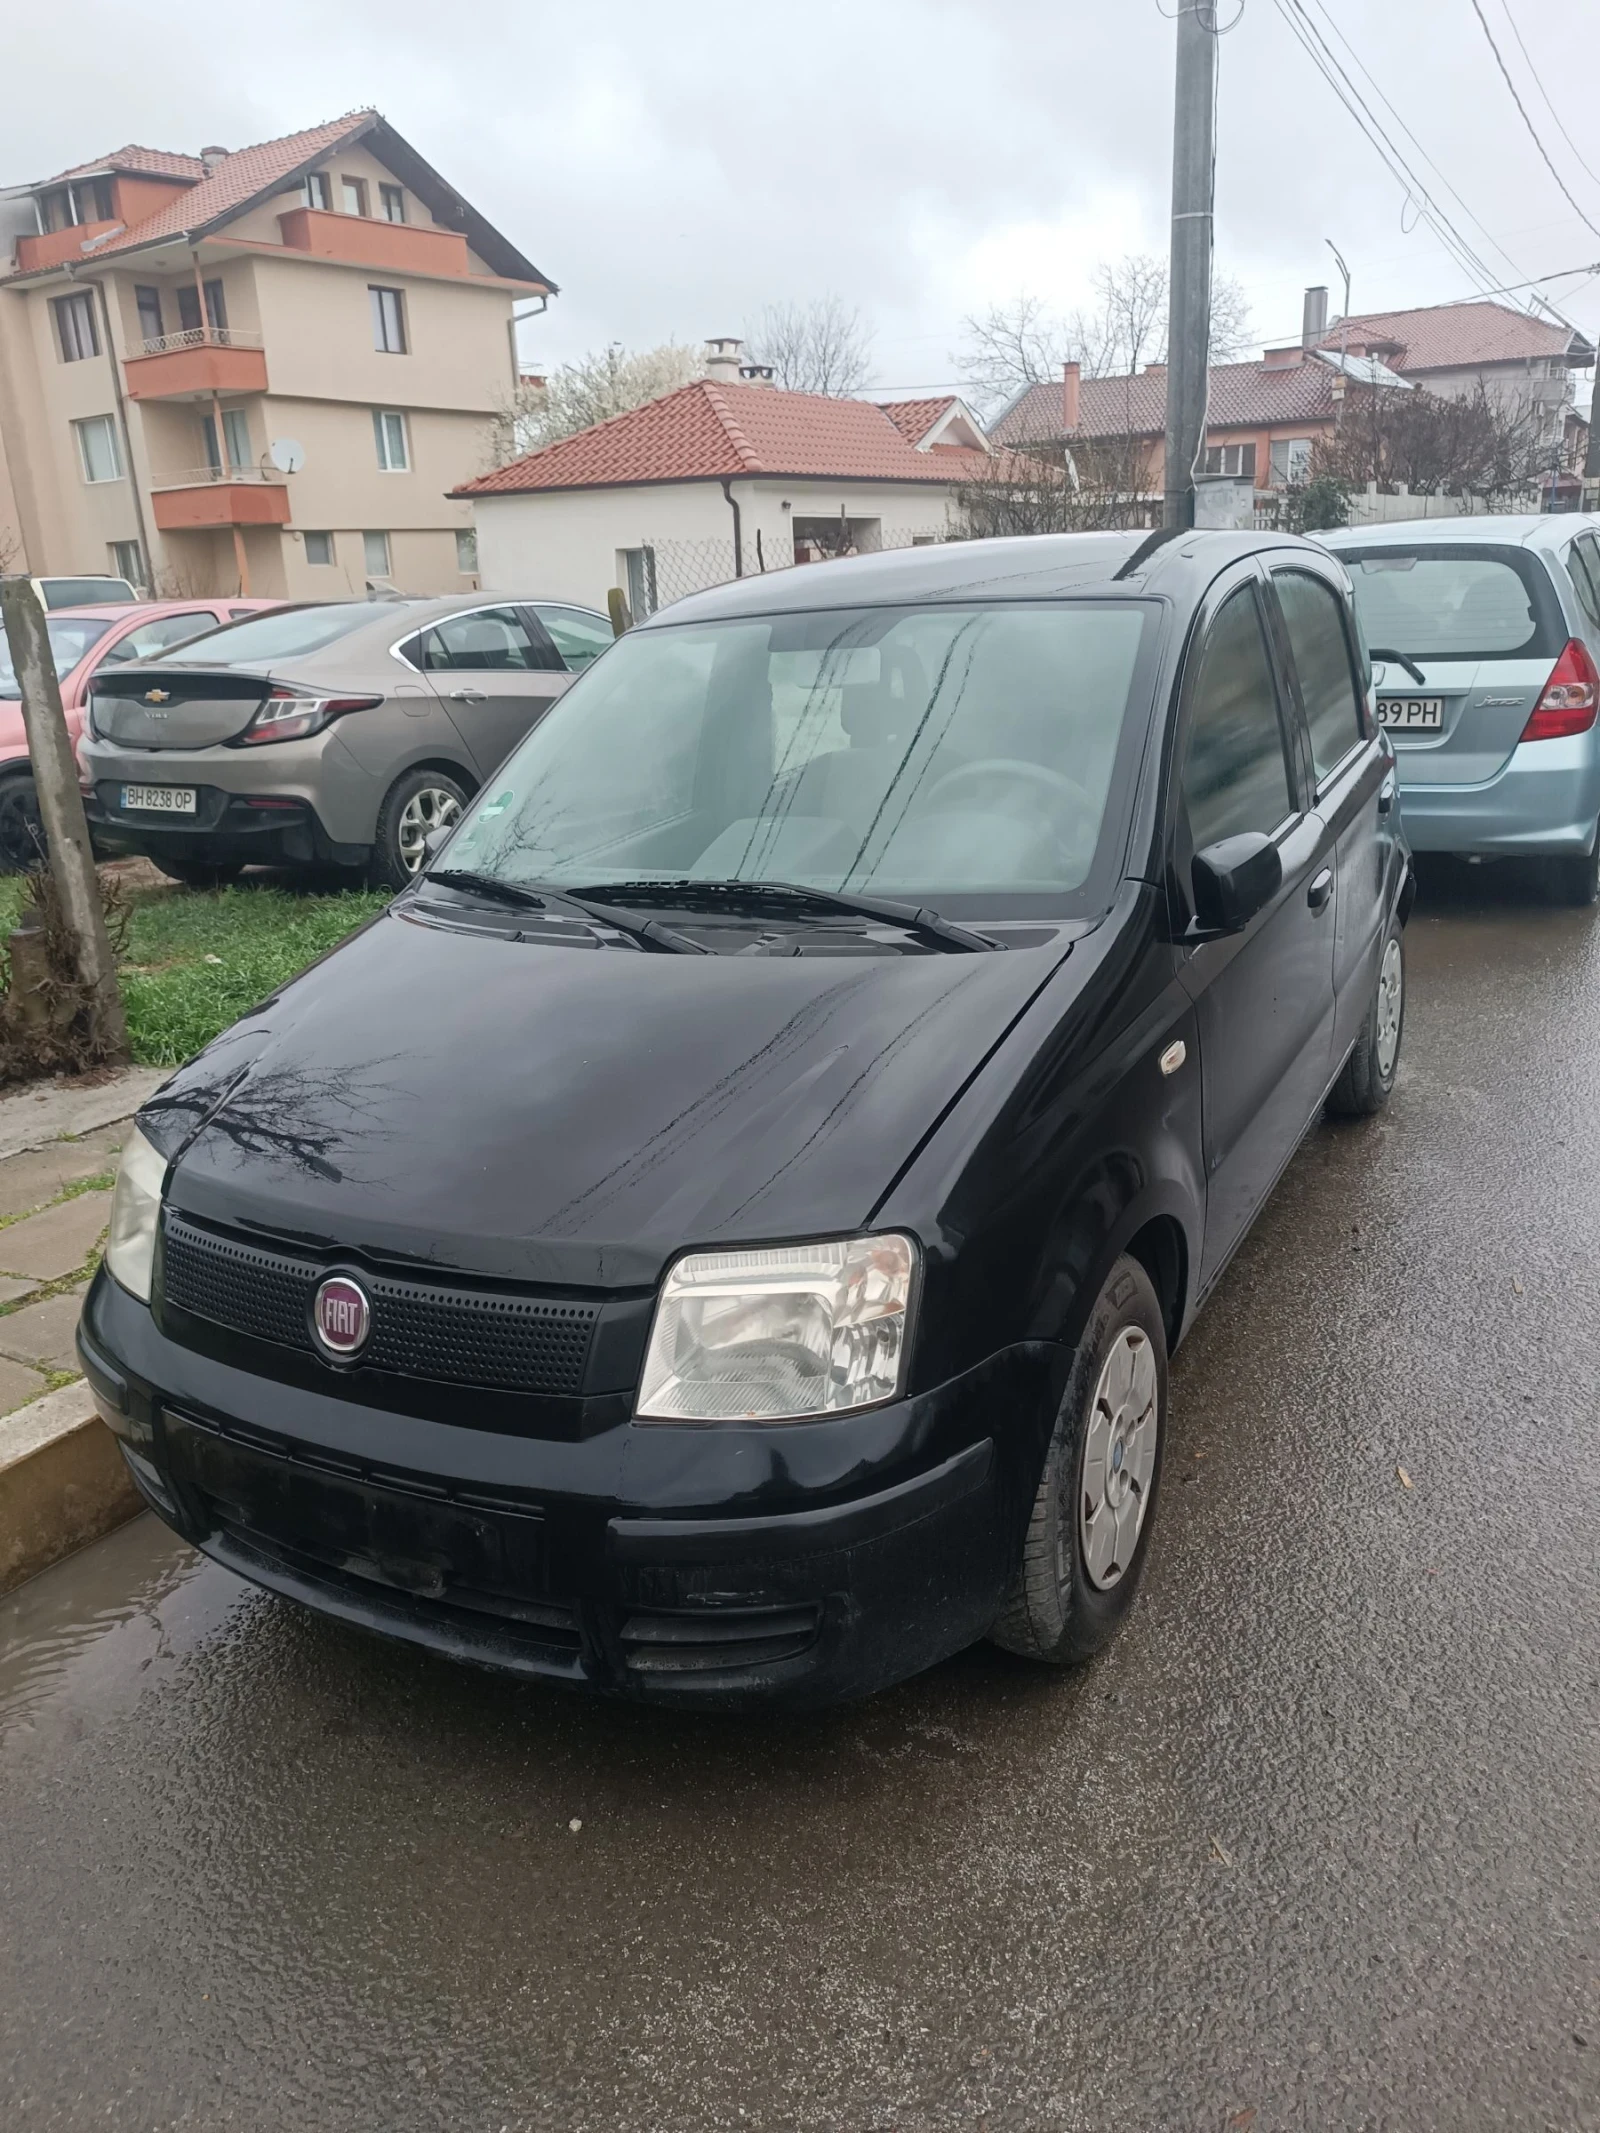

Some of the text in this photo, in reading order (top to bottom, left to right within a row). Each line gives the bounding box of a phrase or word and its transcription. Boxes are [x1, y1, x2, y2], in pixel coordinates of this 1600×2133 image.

[1407, 702, 1437, 724] PH
[128, 788, 192, 809] BH 8238 OP
[325, 1298, 358, 1335] FIAT
